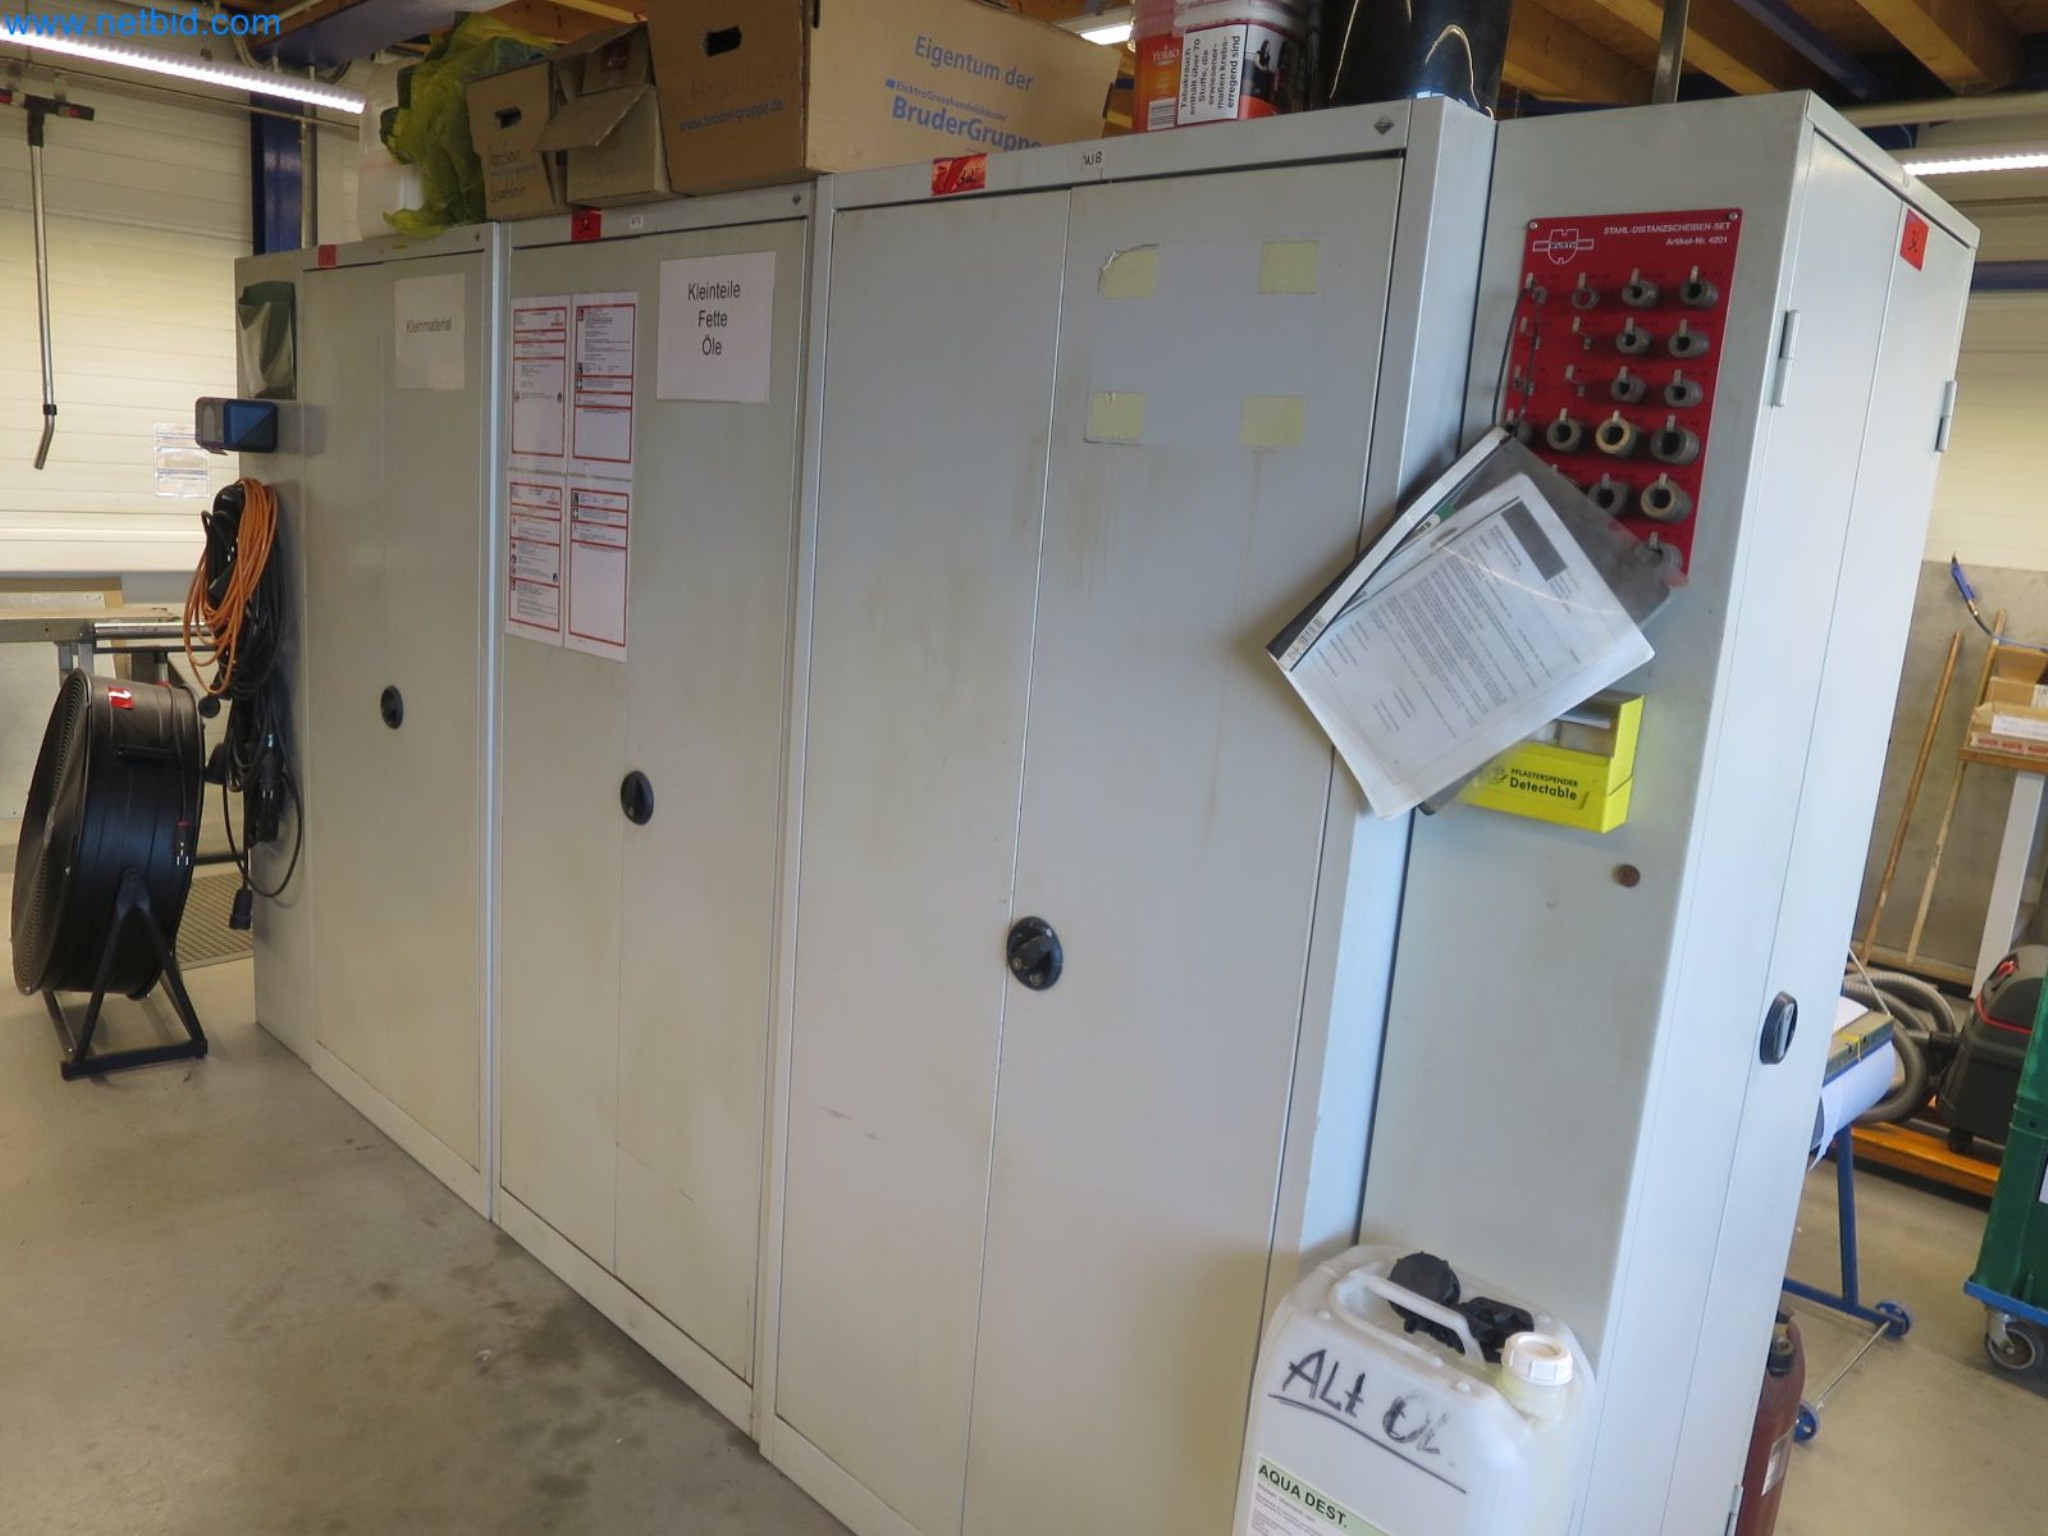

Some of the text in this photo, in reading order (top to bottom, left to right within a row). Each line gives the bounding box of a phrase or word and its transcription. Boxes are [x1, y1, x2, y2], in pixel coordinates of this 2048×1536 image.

[914, 34, 1033, 91] Eigentum der
[1181, 48, 1191, 109] Tabakrauch
[1190, 38, 1201, 116] enthält über 70
[1198, 49, 1209, 102] Stoffe, die
[1208, 43, 1217, 105] erwiesener-
[1217, 37, 1228, 109] maßen krebs-
[1227, 35, 1240, 109] erregend sind
[1603, 221, 1731, 235] STAHL-DISTANZSCHEIBEN-SET
[1666, 235, 1728, 246] Artikel-Nr. 4201
[687, 280, 741, 301] Kleinteile
[406, 317, 452, 334] Kleinmaterial
[698, 309, 728, 328] Fette
[702, 333, 722, 356] Öle
[1510, 768, 1578, 787] PFLASTERSPENDER
[1510, 777, 1577, 801] Detectable
[1258, 1463, 1301, 1500] AQUA
[1304, 1490, 1348, 1529] DEST.
